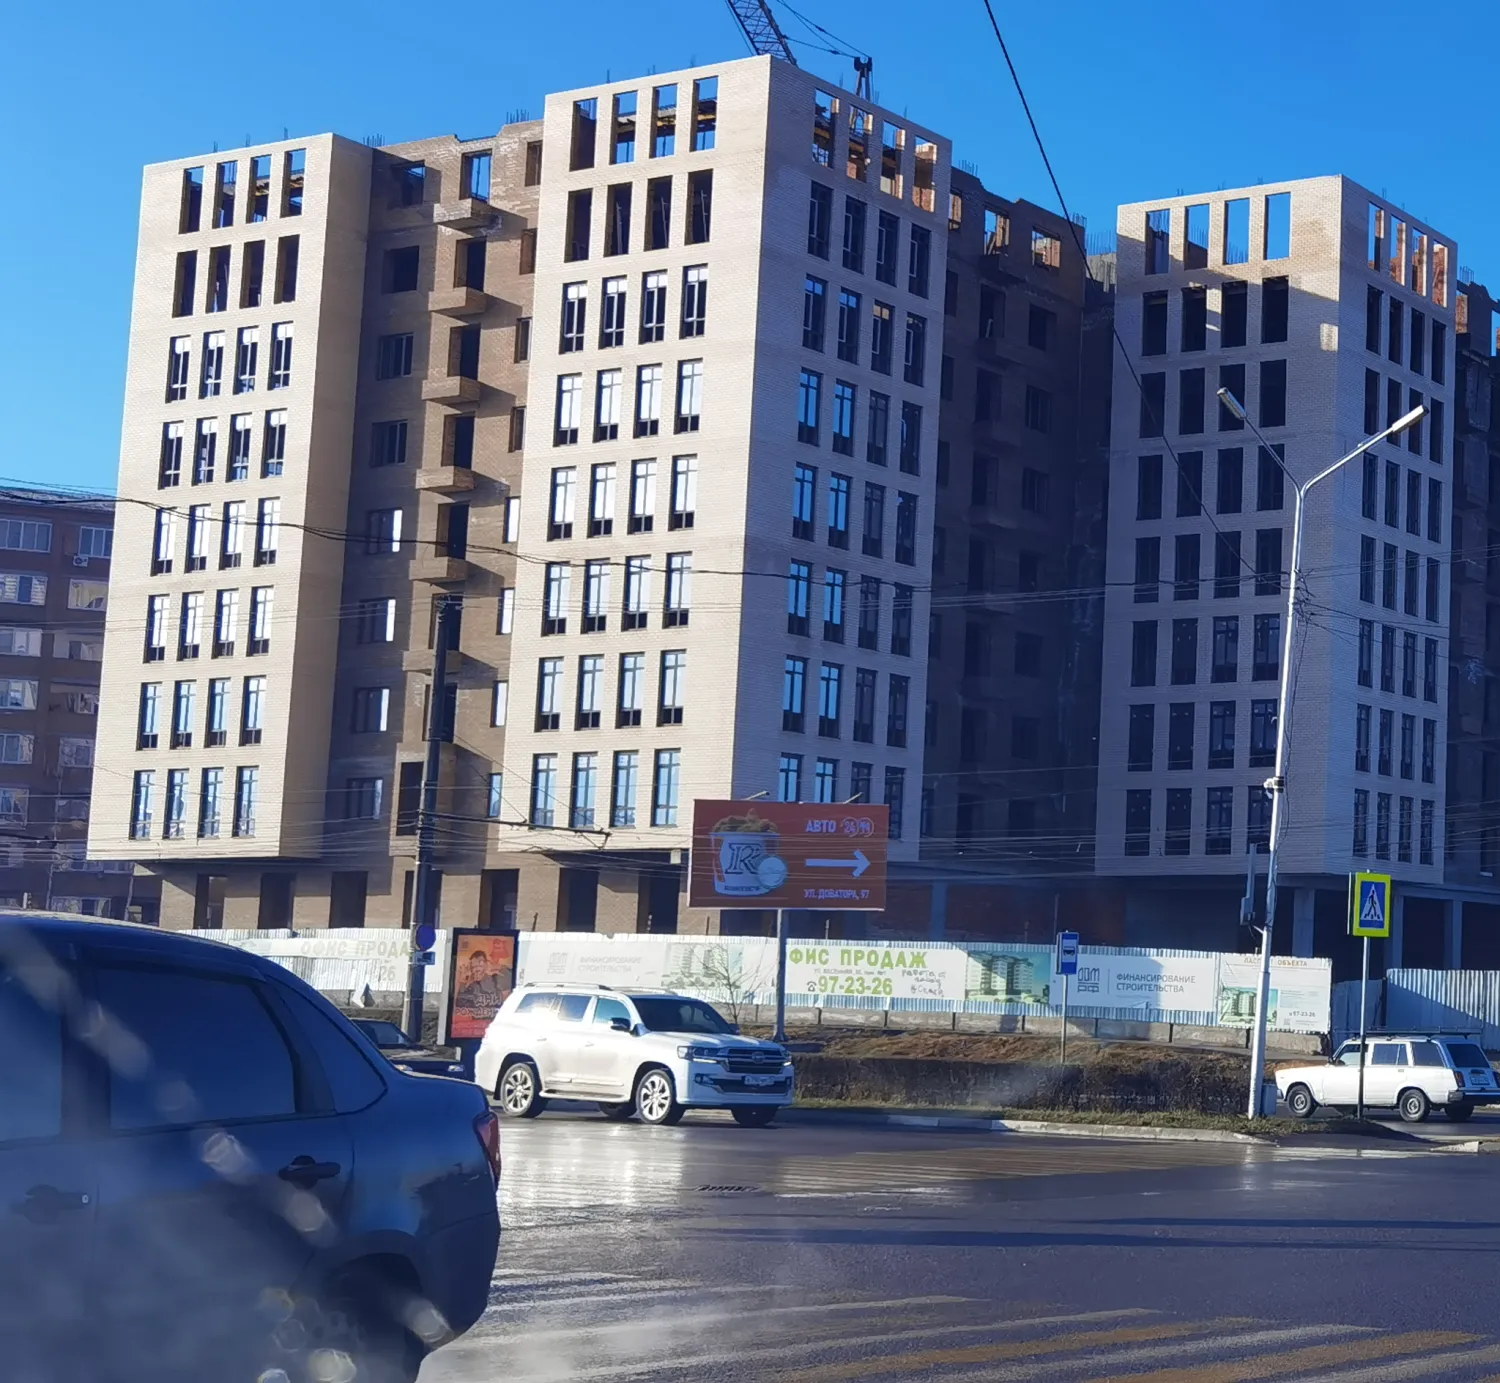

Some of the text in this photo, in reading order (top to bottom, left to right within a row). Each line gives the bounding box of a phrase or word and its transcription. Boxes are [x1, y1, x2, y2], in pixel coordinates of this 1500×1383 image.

[805, 820, 837, 833] АВТО
[300, 940, 411, 959] ОФИС ПРОДА
[840, 949, 928, 969] ПРОДАЖ
[1277, 959, 1308, 967] ОБЪЕКТА
[1077, 968, 1100, 981] ДОМ
[1116, 972, 1197, 984] ФИНАНСИРОВАНИЕ
[818, 976, 893, 996] 97-23-26
[1116, 983, 1185, 993] СТРОИТЕЛЬСТВА
